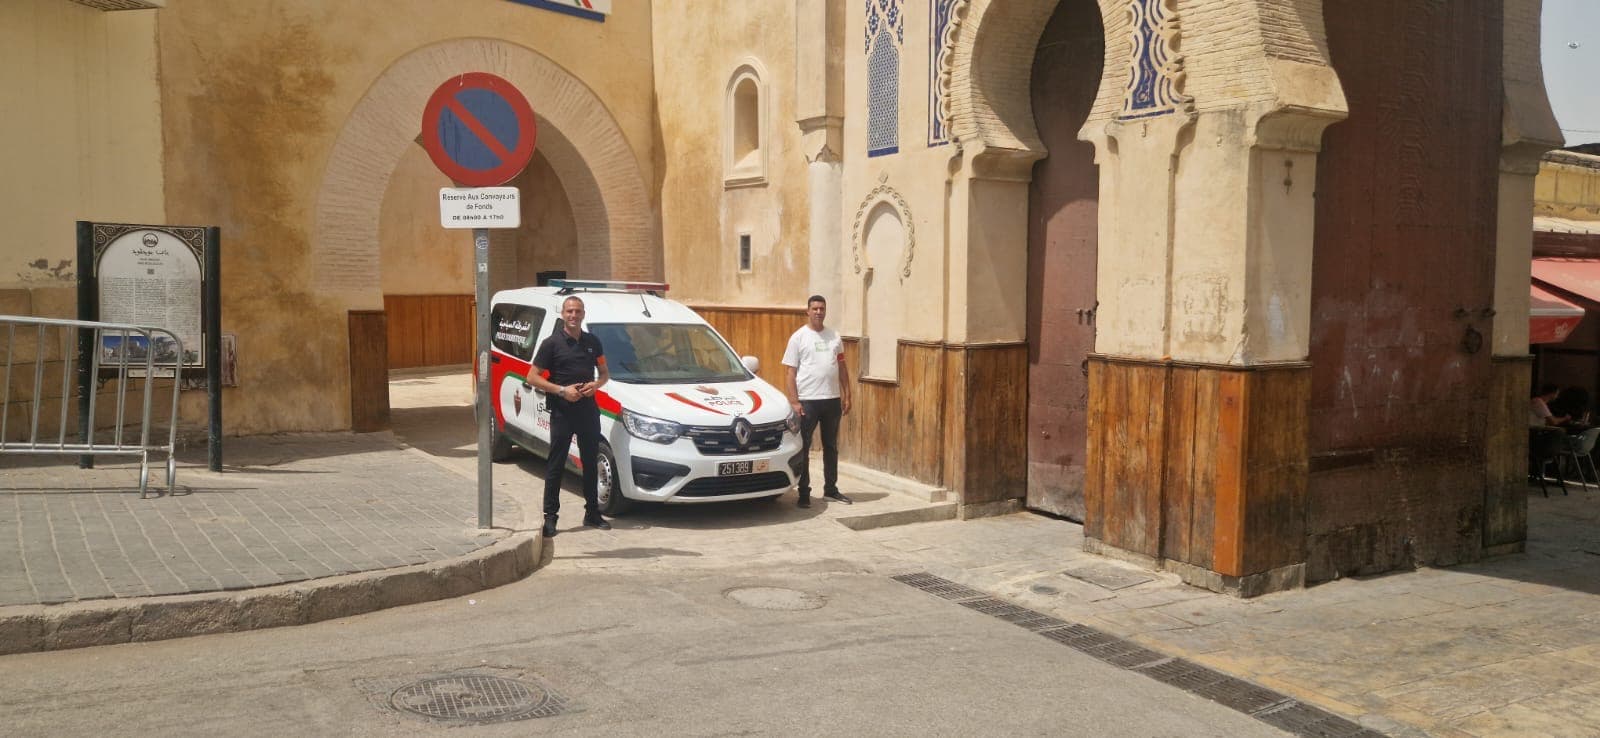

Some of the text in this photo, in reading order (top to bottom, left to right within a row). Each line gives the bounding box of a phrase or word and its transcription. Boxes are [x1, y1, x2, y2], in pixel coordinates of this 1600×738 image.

[468, 193, 479, 201] Aux
[481, 193, 516, 201] Convoyeurs
[721, 462, 749, 475] 251389
